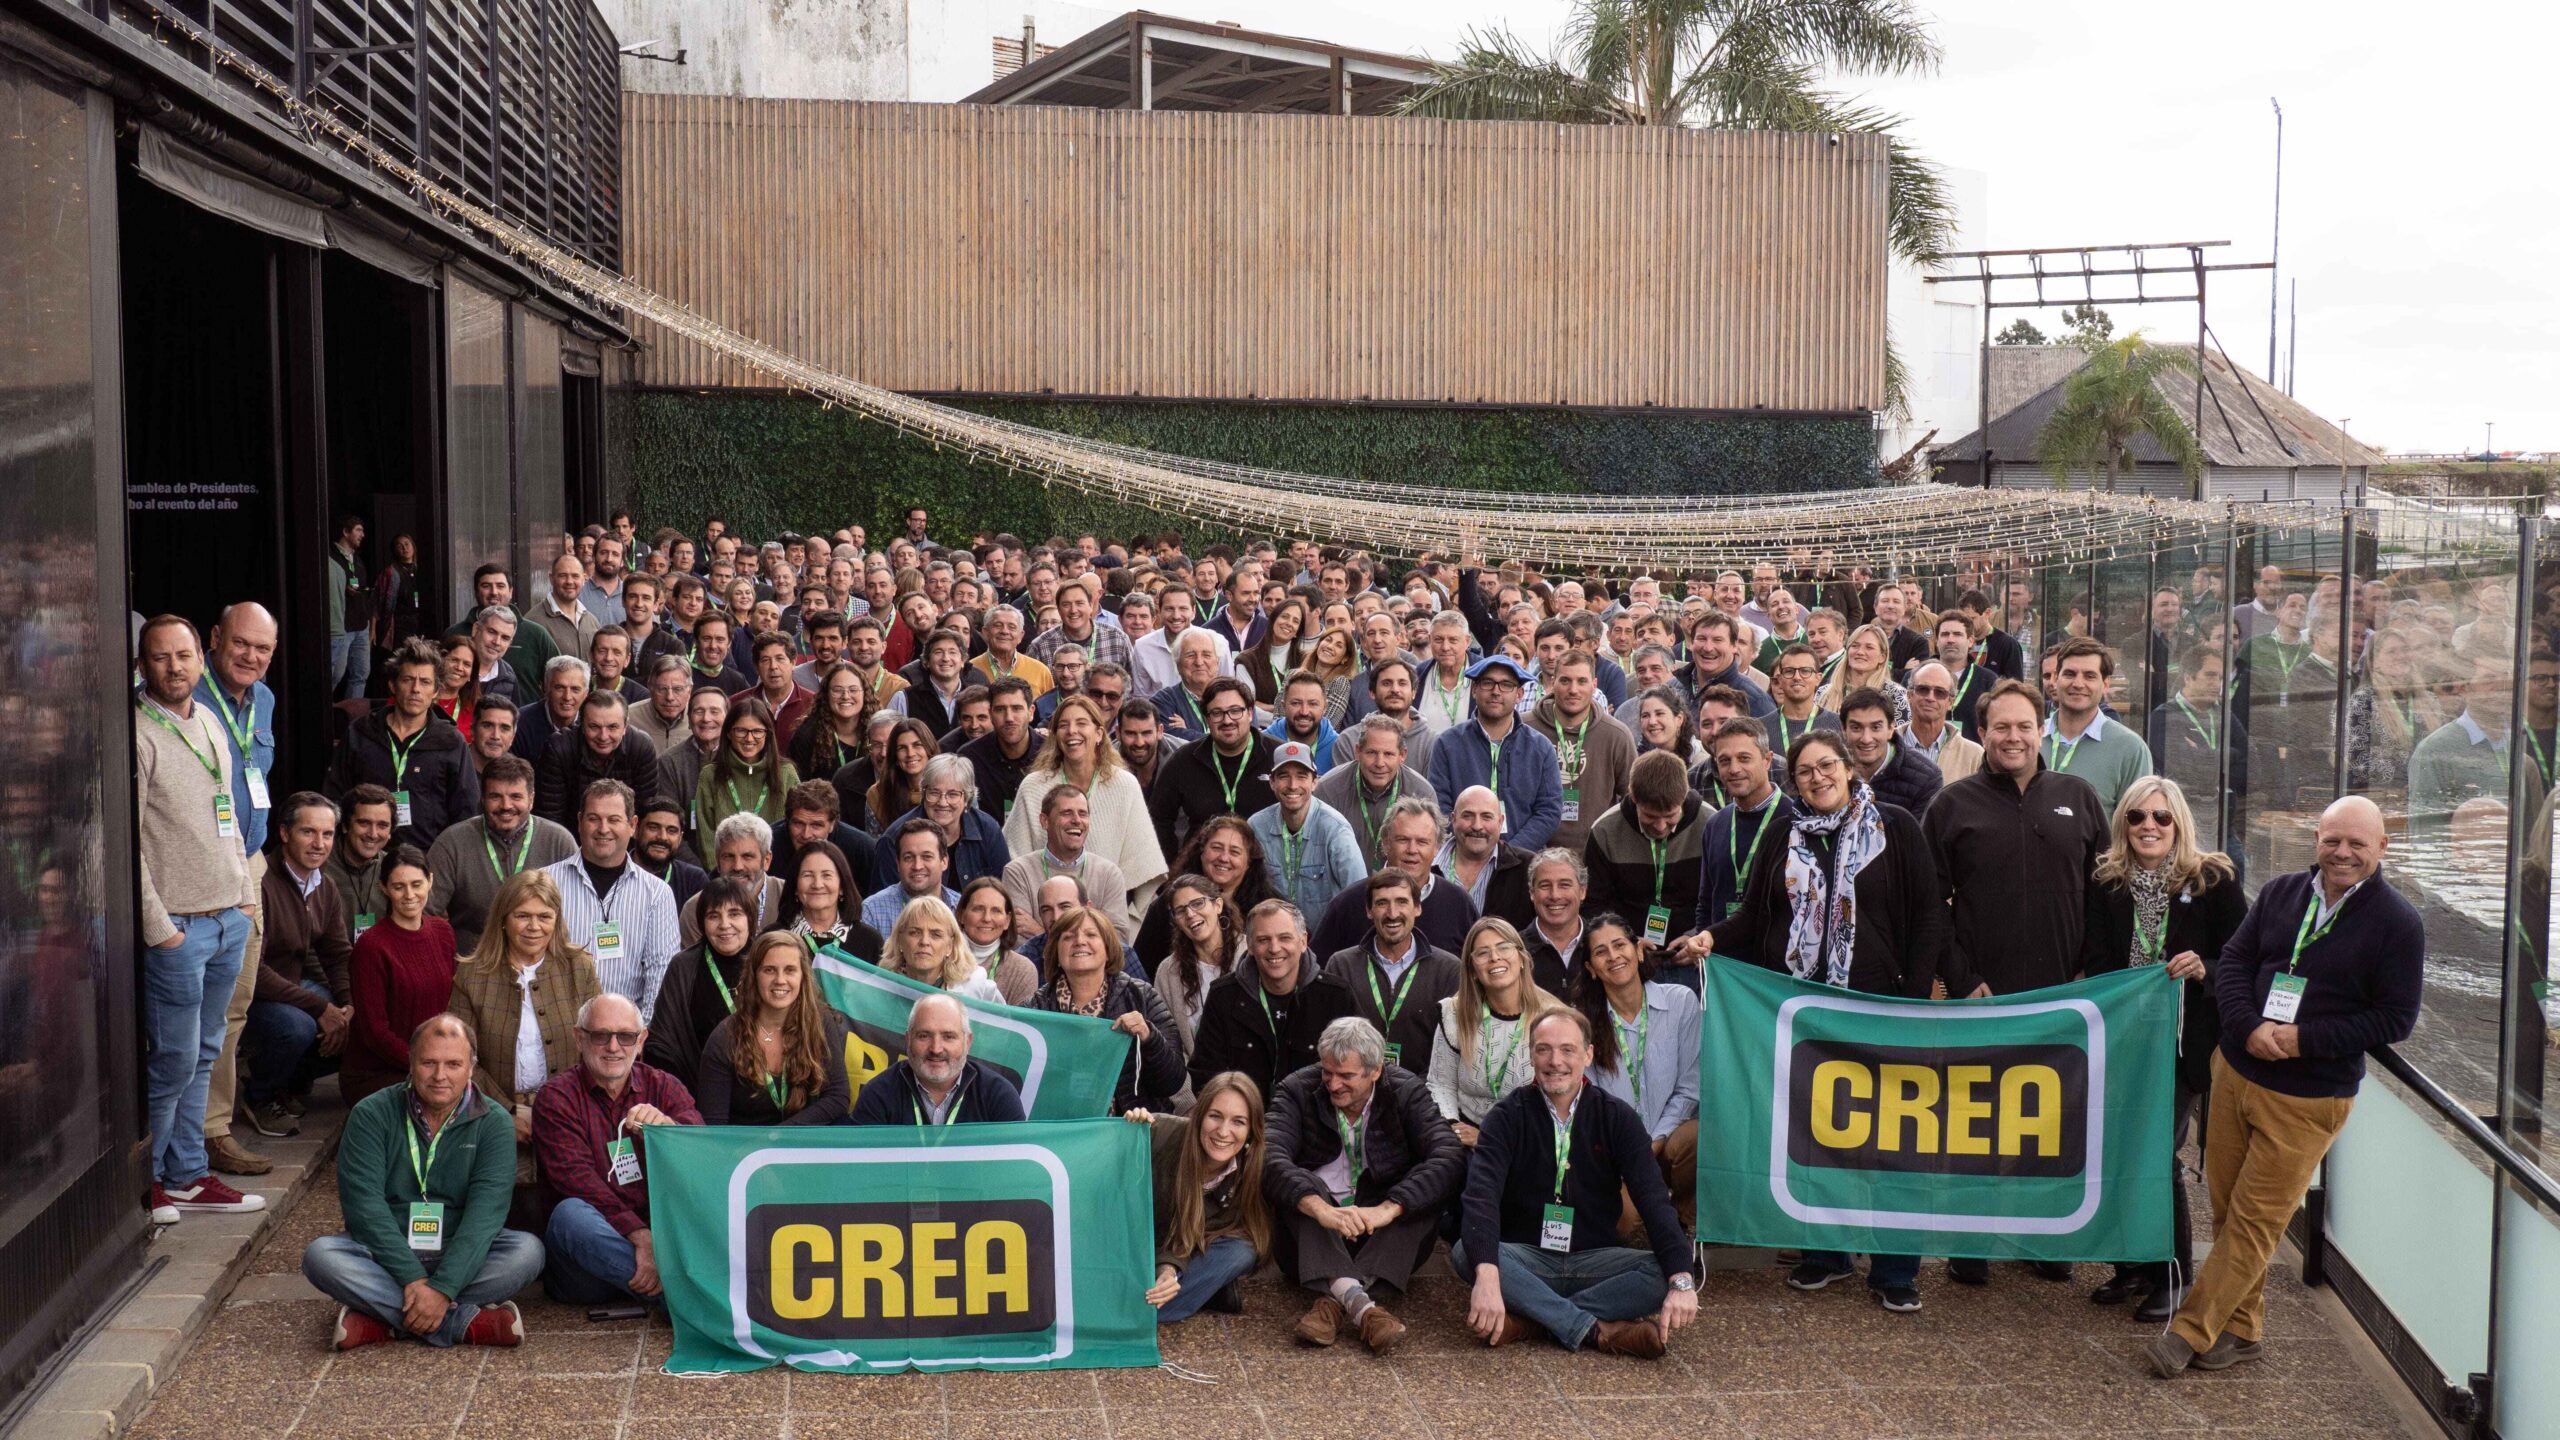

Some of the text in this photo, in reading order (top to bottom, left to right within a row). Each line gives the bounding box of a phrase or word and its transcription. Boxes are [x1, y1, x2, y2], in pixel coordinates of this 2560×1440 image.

[173, 482, 188, 493] de
[145, 499, 156, 509] al
[157, 499, 196, 509] evento
[197, 499, 215, 509] del
[217, 498, 238, 509] año
[1648, 919, 1666, 929] CREA
[598, 936, 618, 946] CREA
[1811, 1060, 2062, 1157] CREA
[413, 1222, 437, 1232] CREA
[770, 1220, 1029, 1319] CREA
